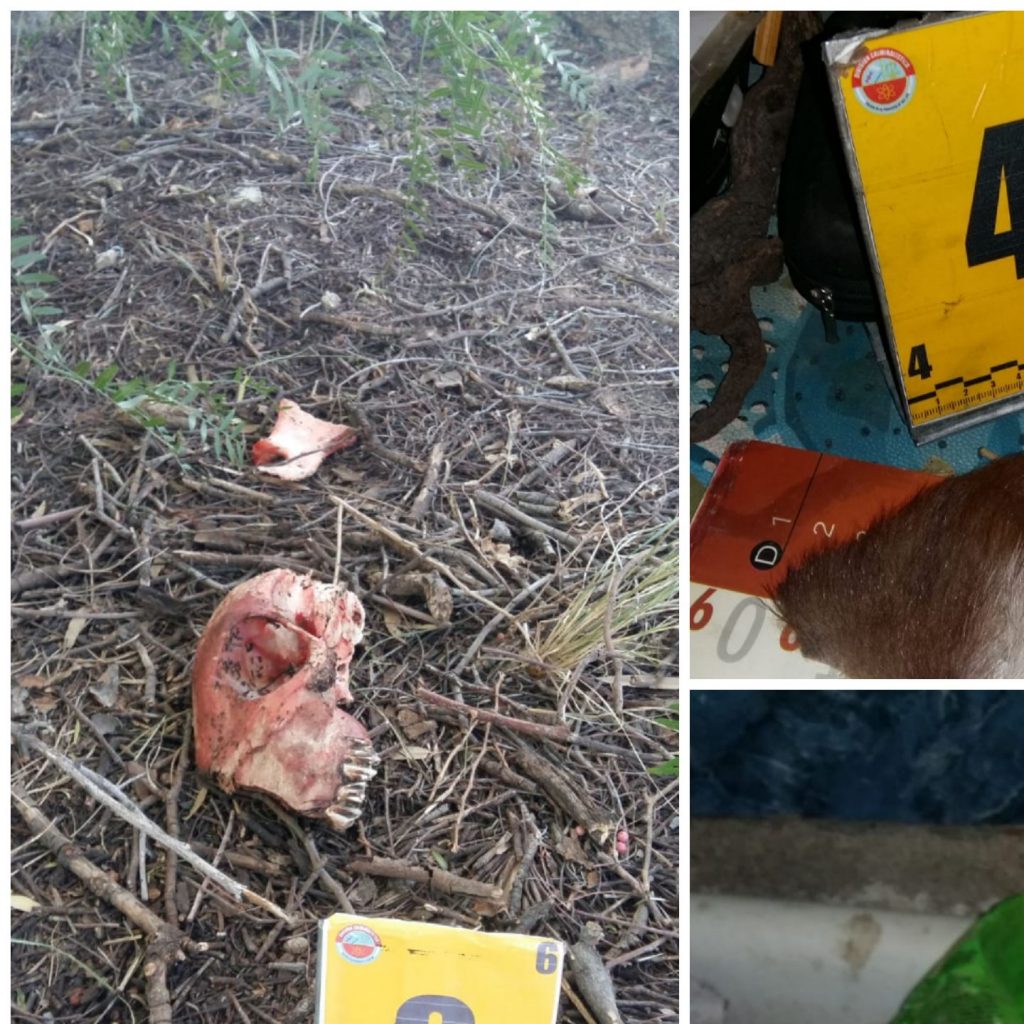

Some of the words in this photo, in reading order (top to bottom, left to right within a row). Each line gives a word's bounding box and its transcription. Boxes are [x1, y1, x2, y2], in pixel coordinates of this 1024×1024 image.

[908, 344, 933, 379] 4
[755, 545, 778, 565] D
[772, 517, 791, 526] 1
[813, 521, 835, 538] 2
[535, 941, 558, 975] 6
